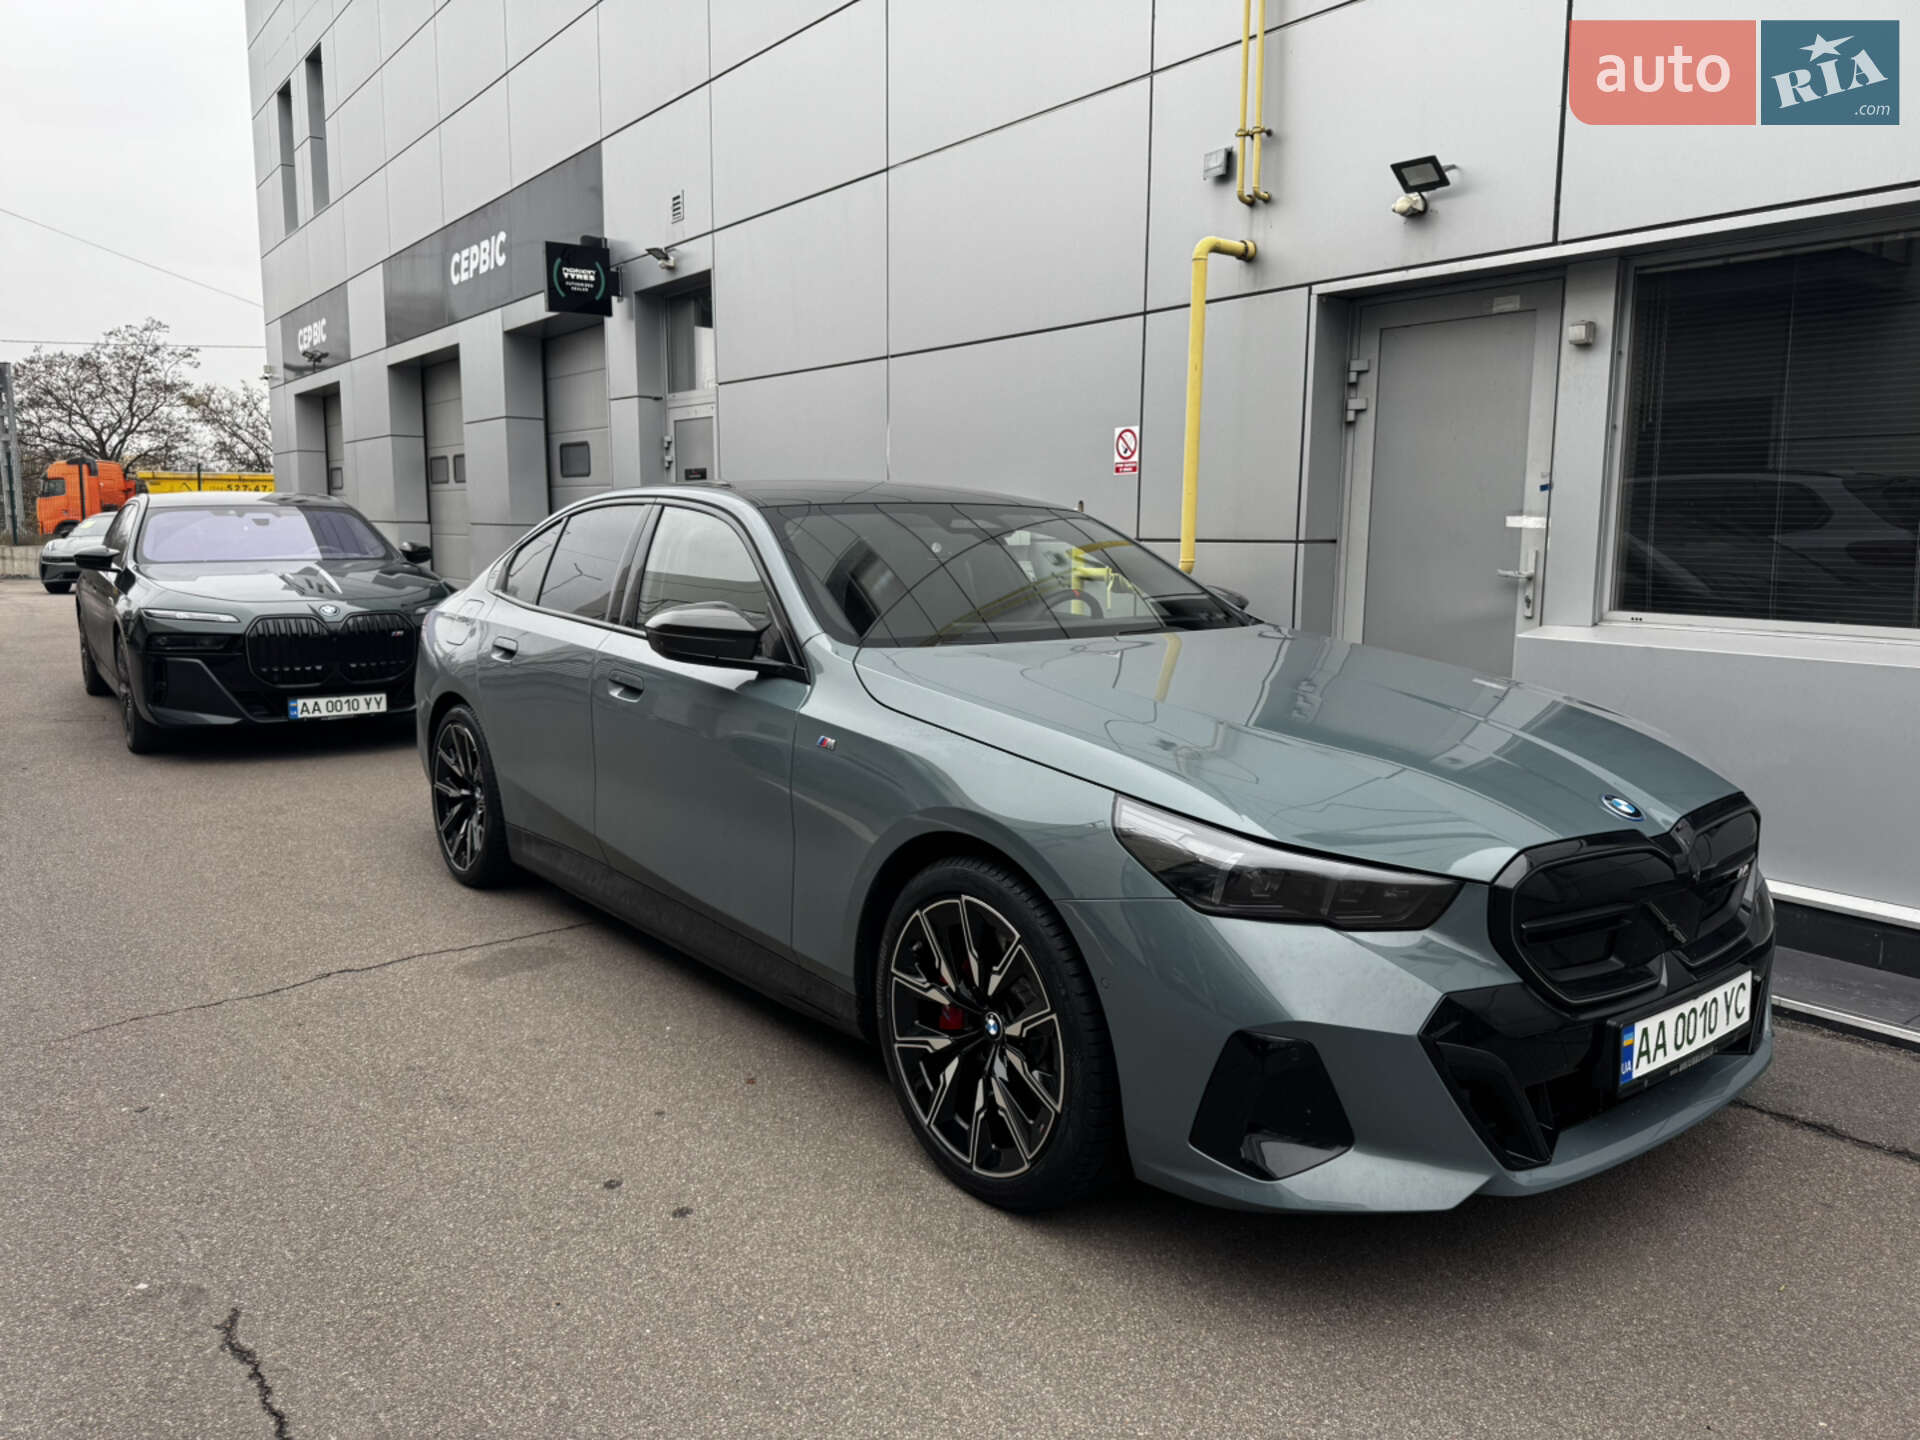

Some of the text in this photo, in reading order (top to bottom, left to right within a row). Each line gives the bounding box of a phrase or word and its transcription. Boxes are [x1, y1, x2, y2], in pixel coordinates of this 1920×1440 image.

[450, 230, 506, 286] СЕРВІС
[297, 317, 328, 352] СЕРВІС
[300, 696, 383, 715] AA 0010 YY
[1635, 1020, 1668, 1070] AA
[1674, 997, 1719, 1051] 0010
[1723, 982, 1746, 1027] YC
[1621, 1060, 1632, 1075] UA
